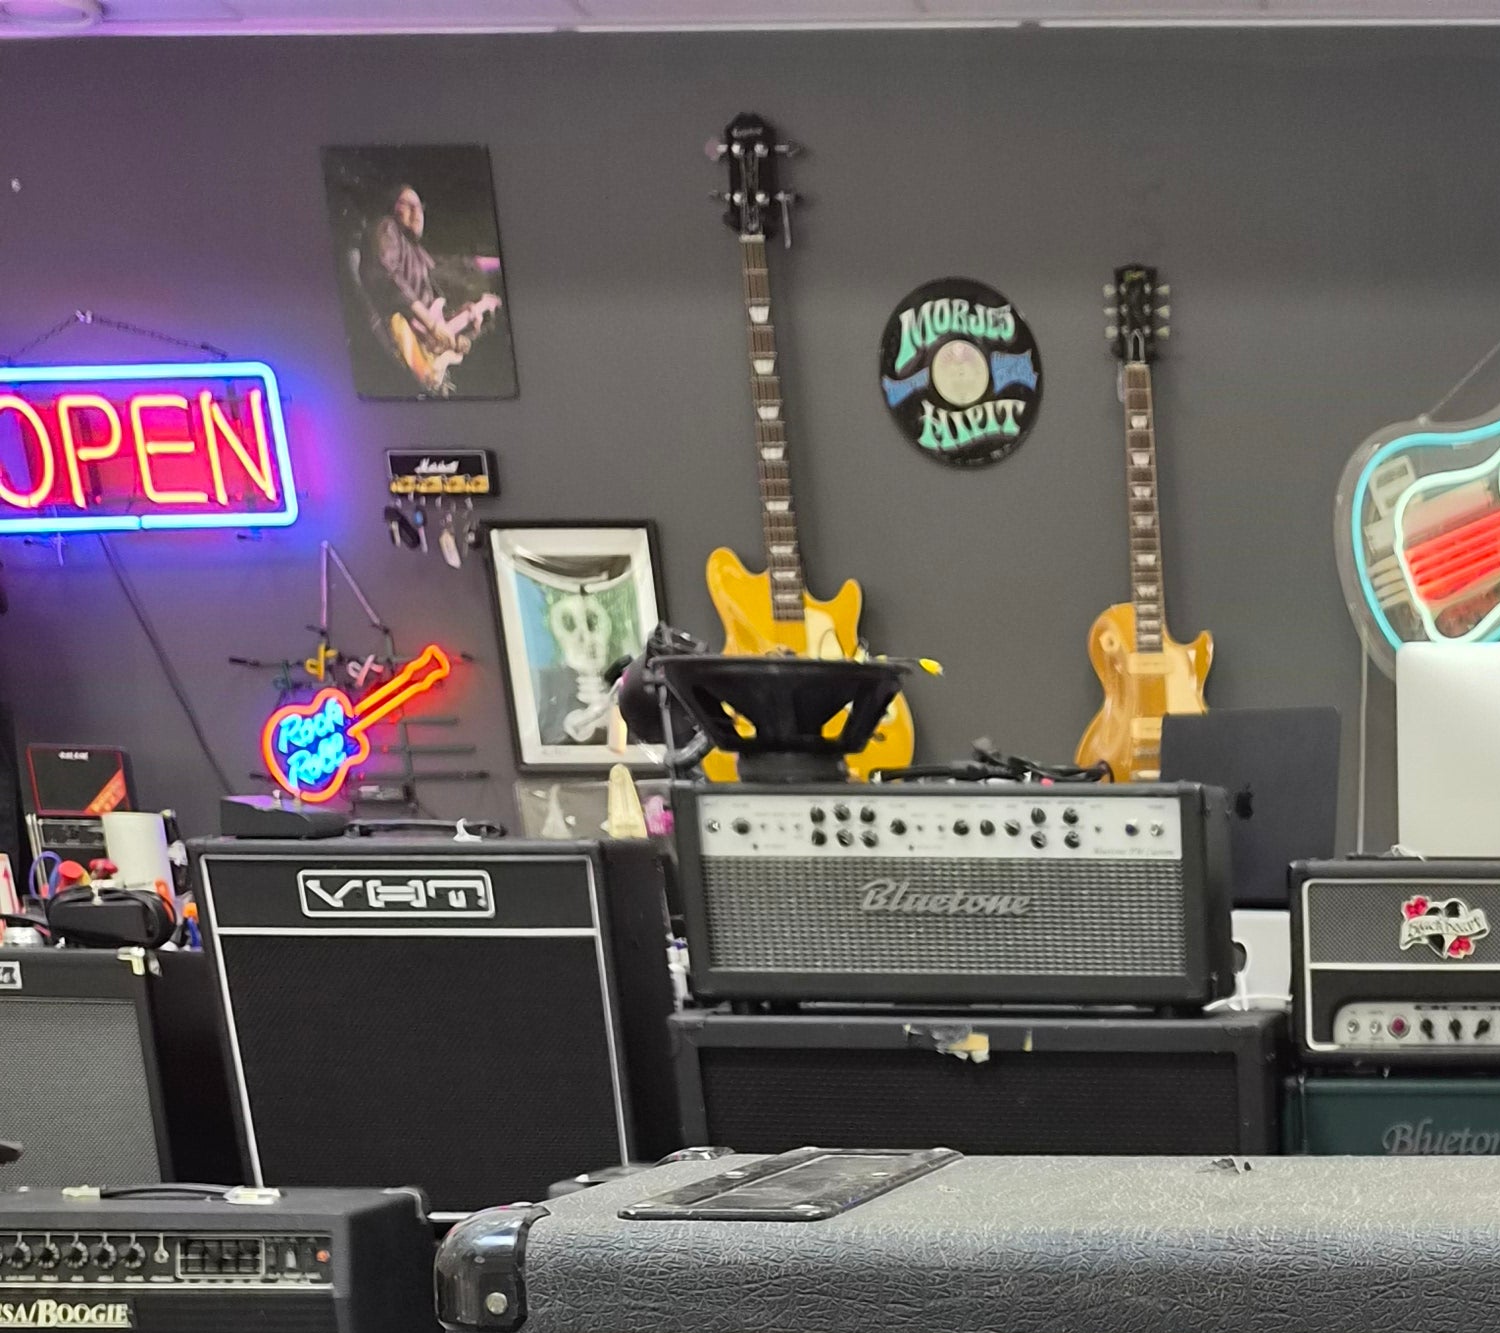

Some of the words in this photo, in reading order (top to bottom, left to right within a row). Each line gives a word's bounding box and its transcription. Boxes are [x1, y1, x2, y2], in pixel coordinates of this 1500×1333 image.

[895, 298, 1015, 374] MORJES
[0, 388, 277, 508] OPEN
[305, 879, 487, 908] VHT
[859, 877, 1032, 917] Bluetone
[0, 1298, 130, 1328] SA/BOOGIE
